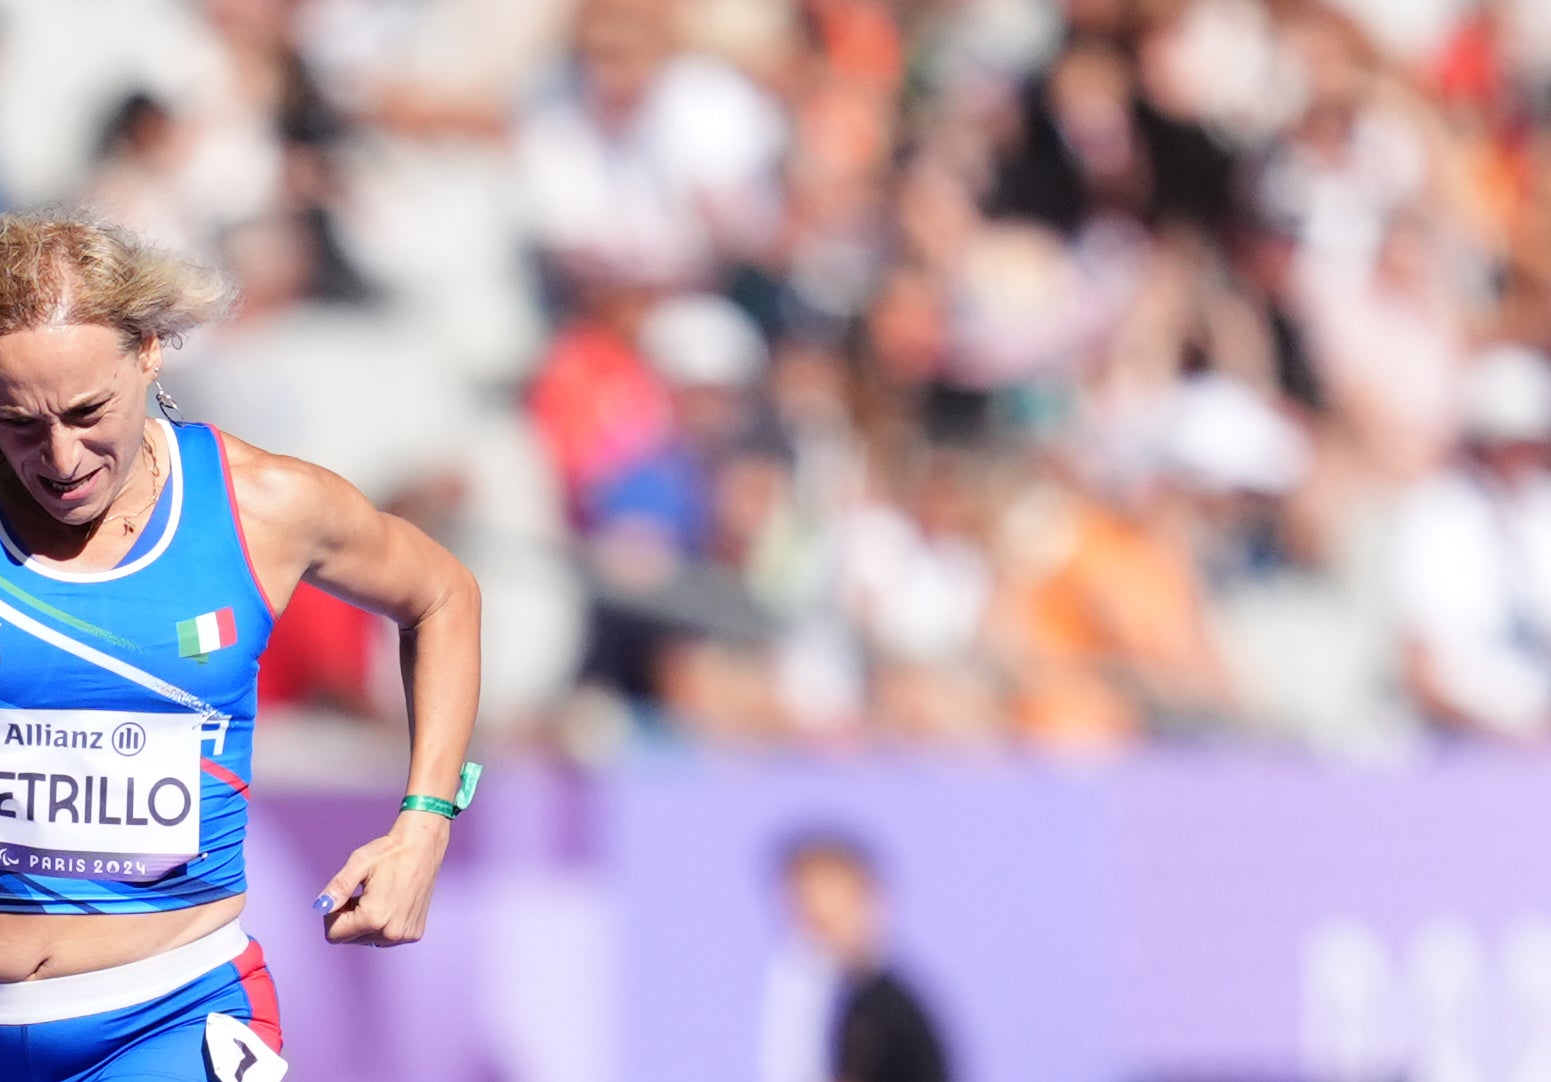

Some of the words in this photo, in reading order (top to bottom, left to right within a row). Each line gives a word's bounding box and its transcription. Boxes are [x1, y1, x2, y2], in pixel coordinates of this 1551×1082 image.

[4, 722, 104, 750] Allianz
[29, 854, 86, 873] PARIS
[93, 859, 147, 876] 2024
